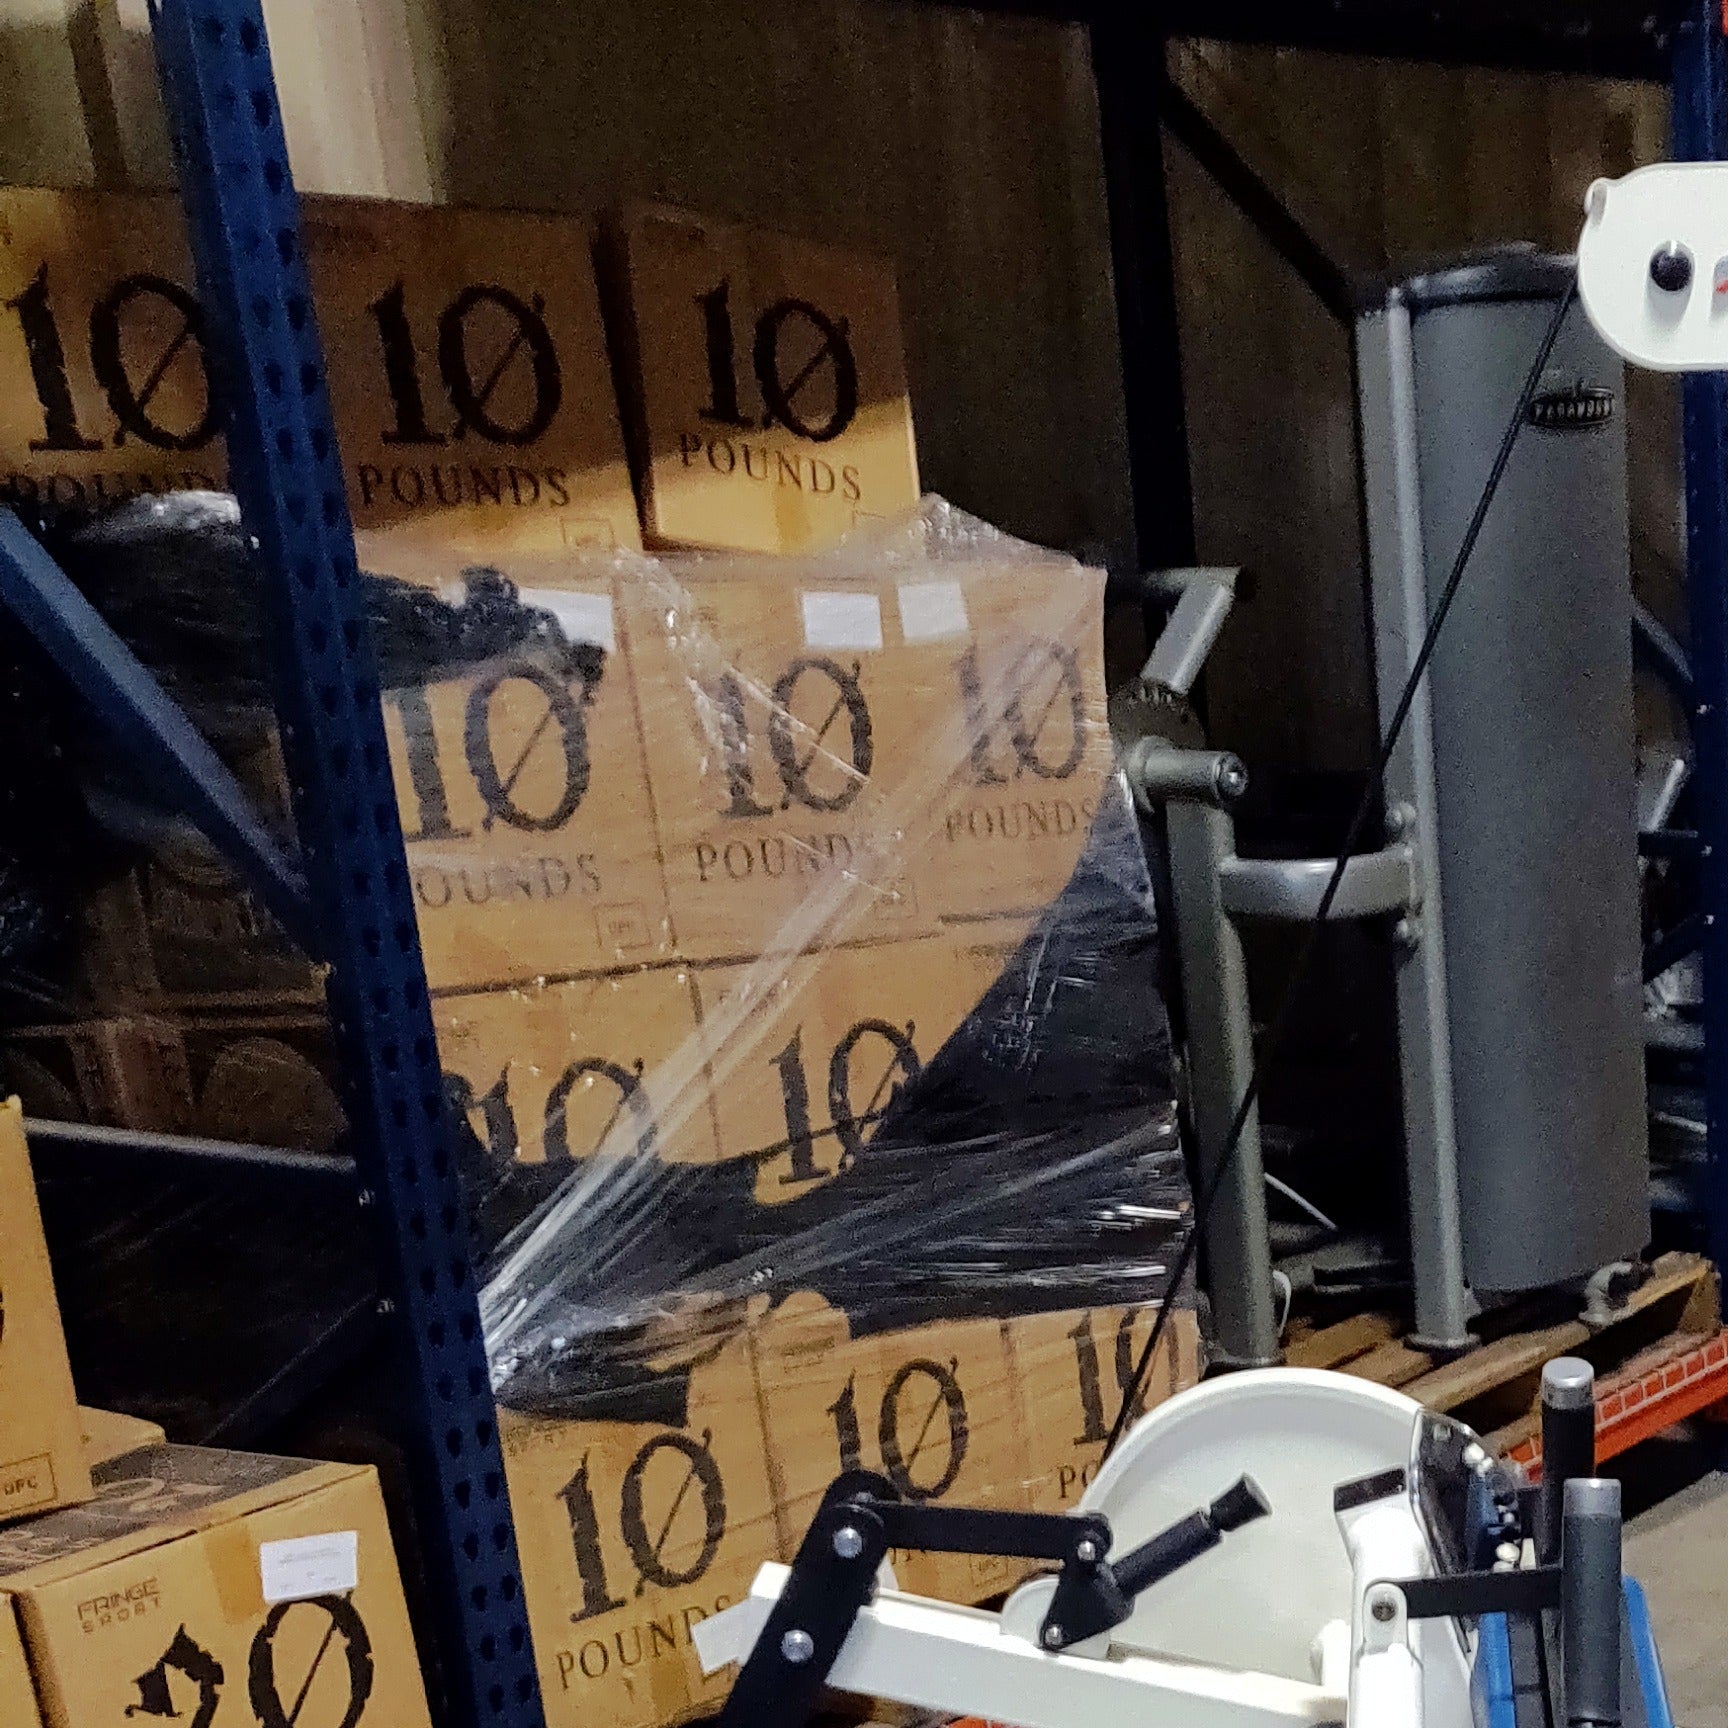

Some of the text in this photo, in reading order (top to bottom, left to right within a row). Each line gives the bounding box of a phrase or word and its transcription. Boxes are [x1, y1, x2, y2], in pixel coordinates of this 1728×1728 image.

[4, 262, 224, 451] 10
[369, 281, 563, 447] 10
[694, 276, 857, 442] 10
[359, 462, 570, 507] POUNDS
[679, 433, 861, 502] POUNDS
[716, 657, 873, 818] 10
[77, 1577, 160, 1620] FRINGE
[555, 1427, 727, 1624] 10
